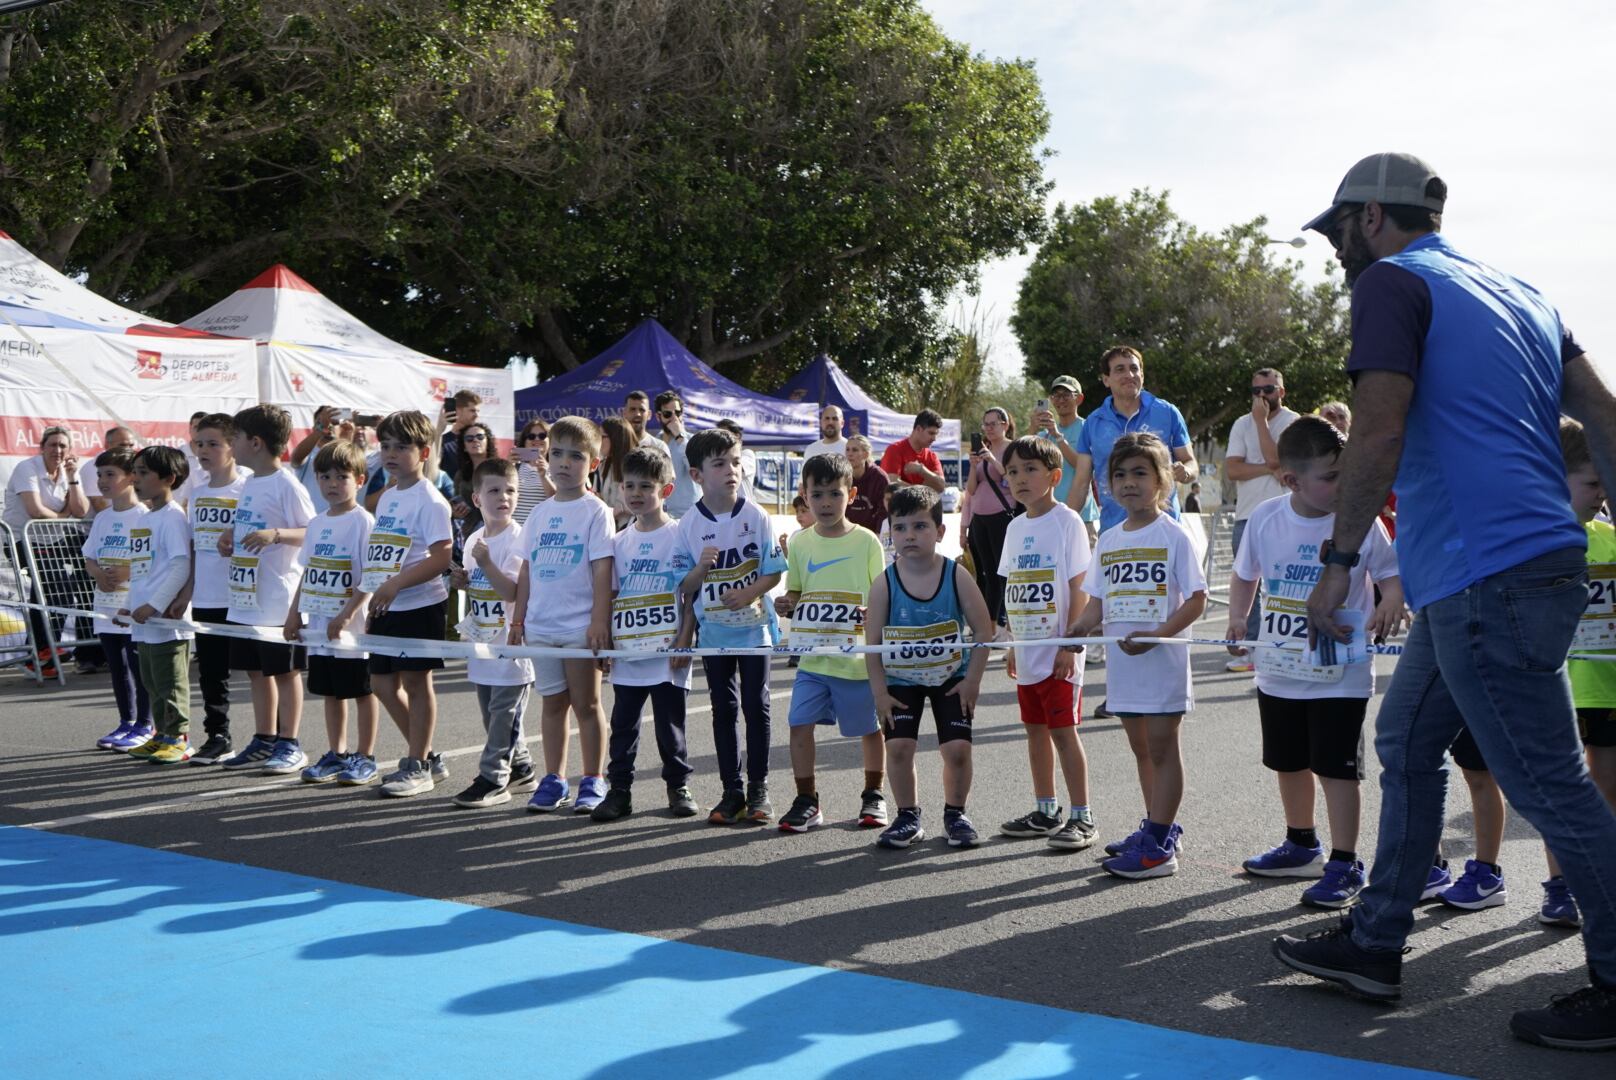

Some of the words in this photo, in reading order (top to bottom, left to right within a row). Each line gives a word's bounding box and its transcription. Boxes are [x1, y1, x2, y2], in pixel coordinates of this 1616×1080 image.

[172, 359, 230, 371] DEPORTES
[172, 371, 187, 381] DE
[576, 407, 592, 420] DE
[16, 428, 103, 449] ALRÍA
[104, 535, 127, 546] SUPER
[130, 537, 151, 553] 91
[539, 532, 567, 546] SUPER
[315, 543, 336, 556] SUPER
[628, 558, 660, 572] SUPER
[1018, 554, 1041, 569] SUPER
[304, 569, 353, 588] 10470
[1104, 562, 1166, 585] 10256
[1007, 583, 1054, 603] 10229
[613, 605, 676, 629] 10555
[796, 603, 863, 624] 10224
